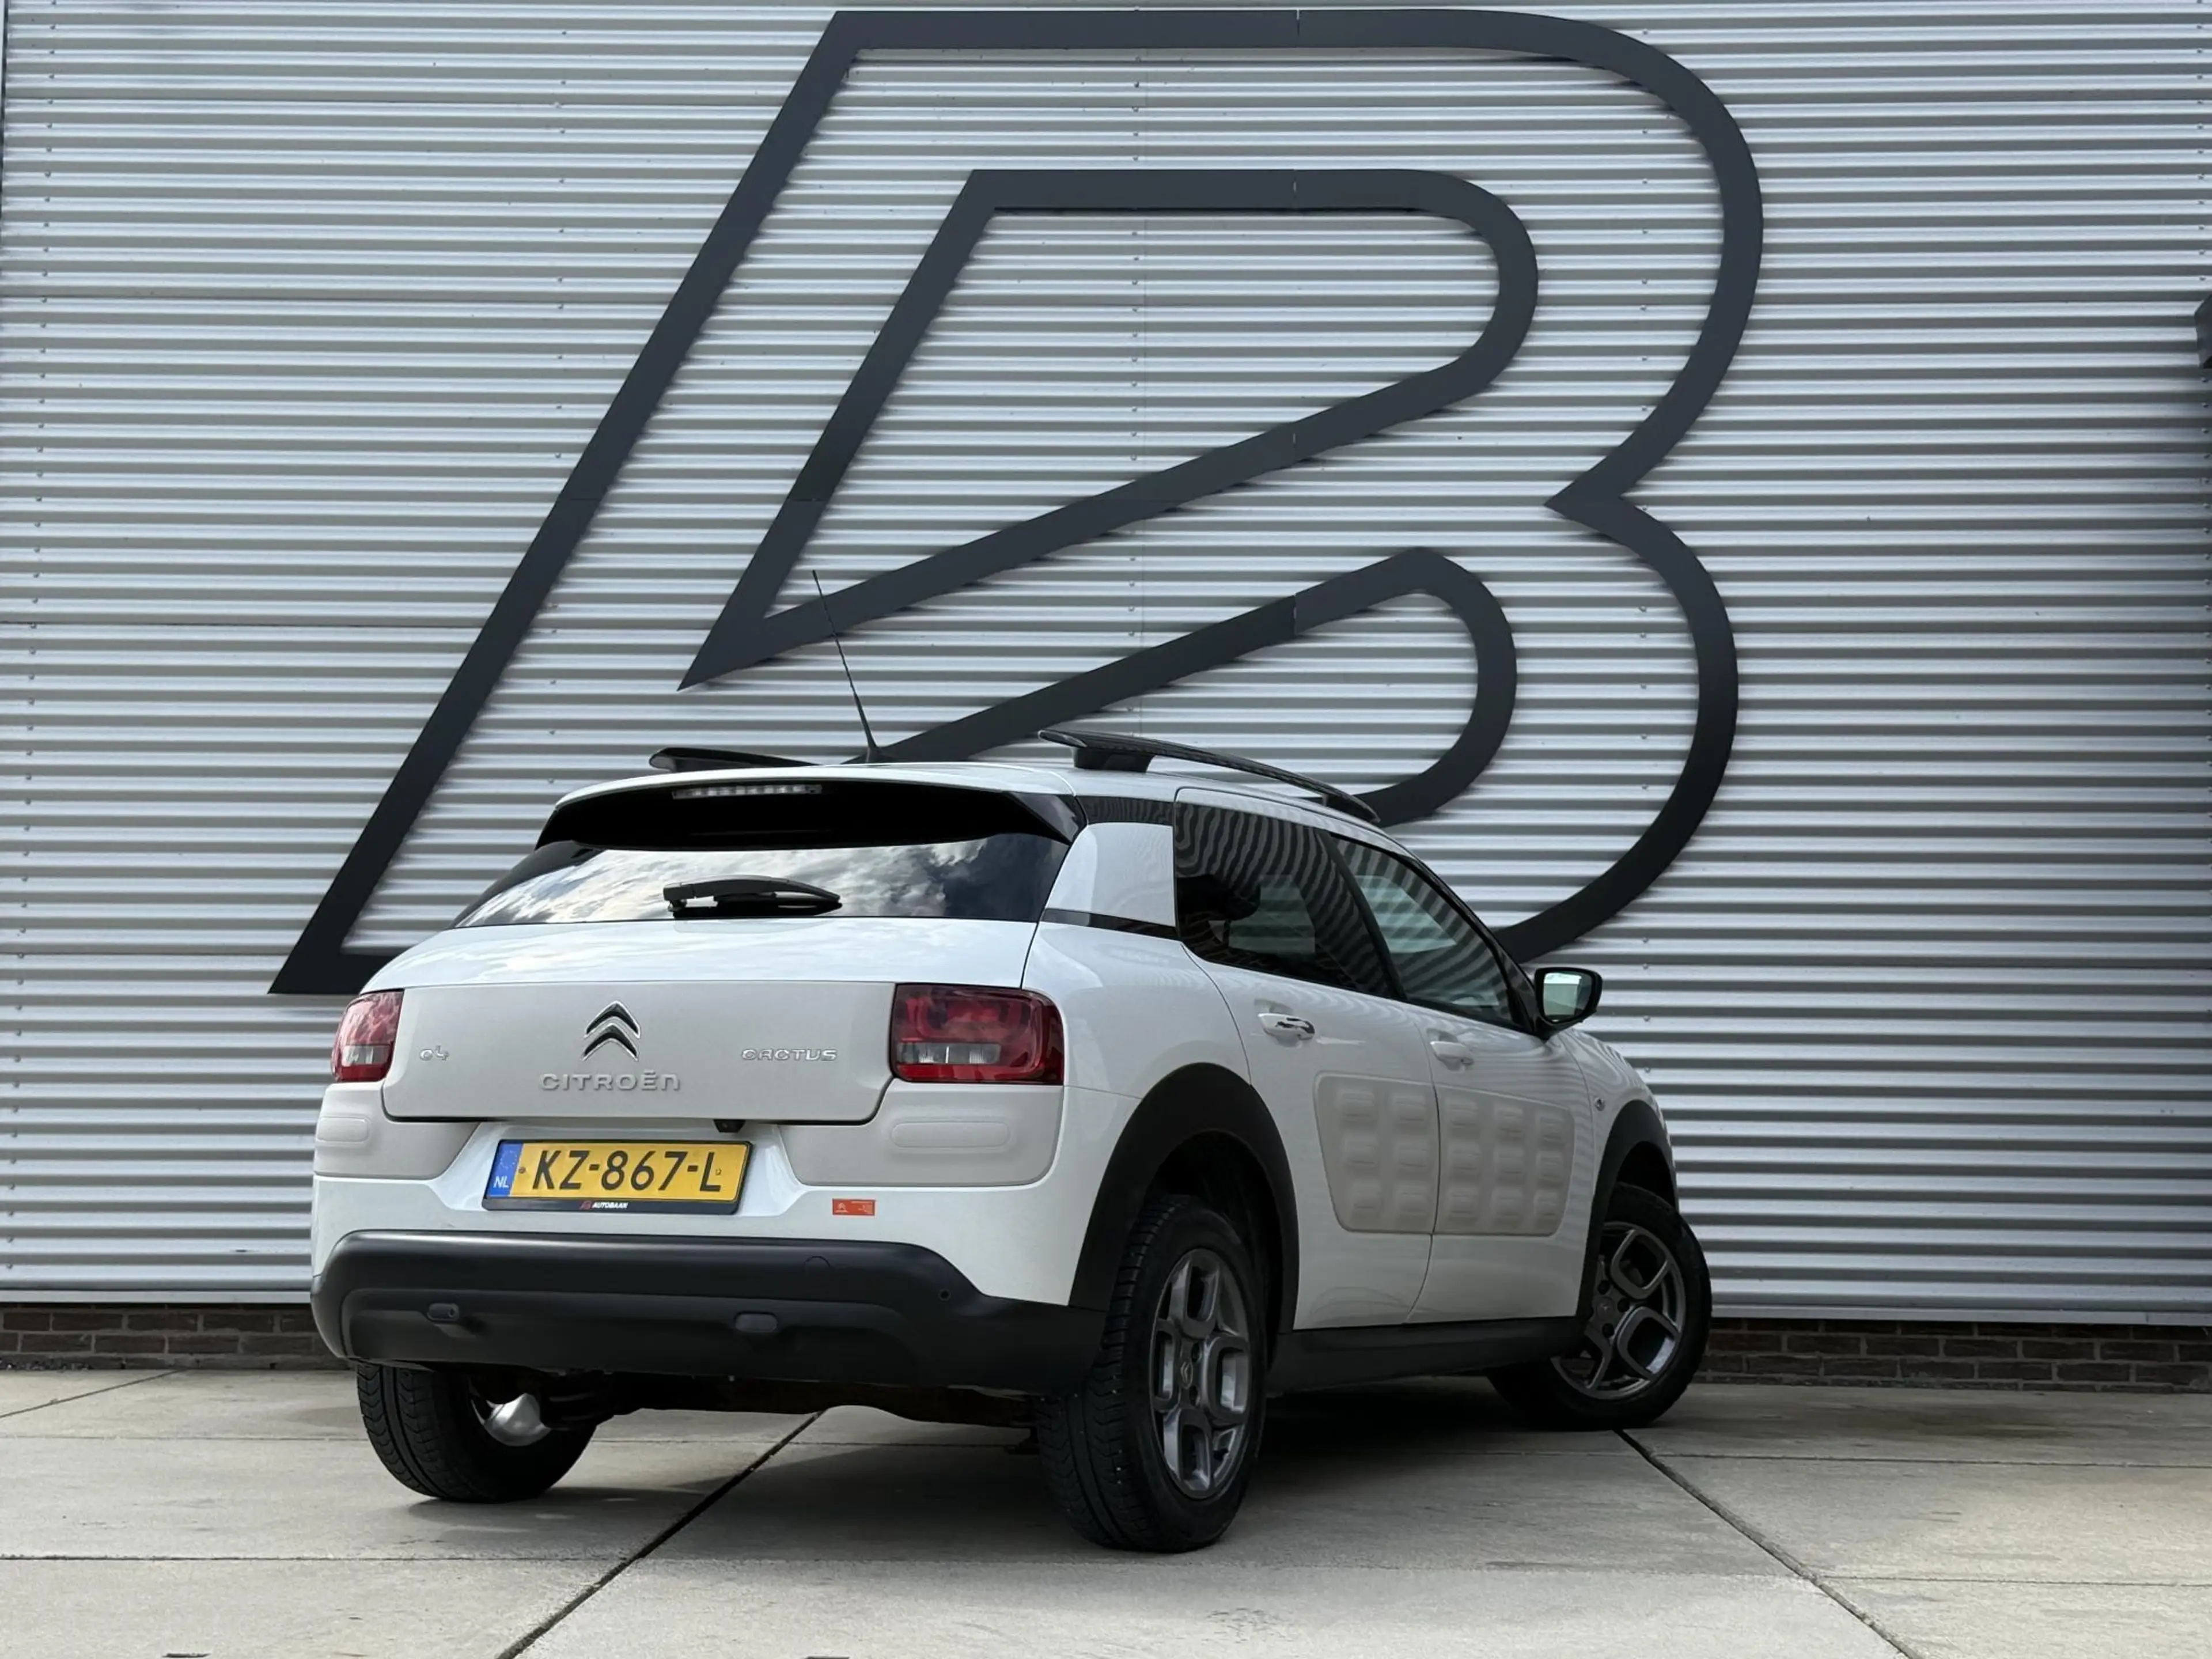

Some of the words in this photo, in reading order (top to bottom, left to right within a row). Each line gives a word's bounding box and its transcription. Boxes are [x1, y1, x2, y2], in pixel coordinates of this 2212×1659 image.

[741, 1048, 836, 1061] CACTUS
[539, 1069, 681, 1091] CITROËN
[532, 1150, 722, 1192] KZ-867-L
[493, 1175, 510, 1188] NL
